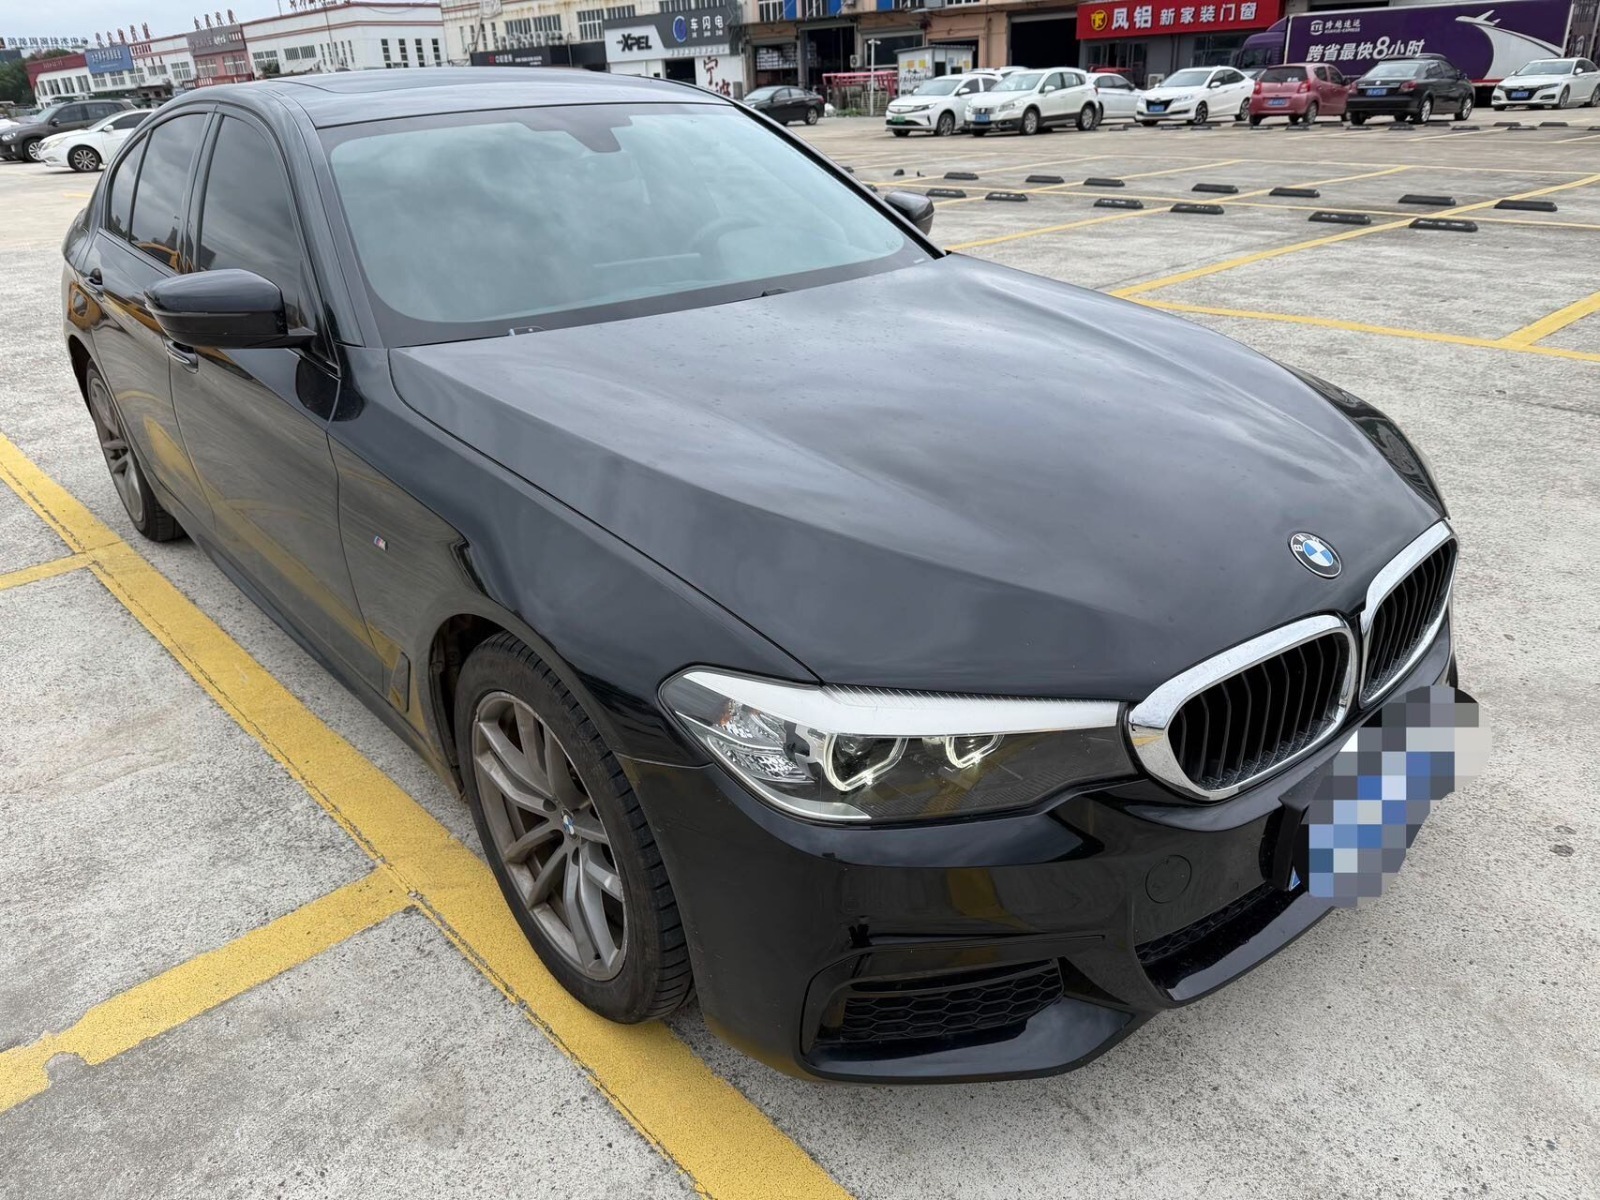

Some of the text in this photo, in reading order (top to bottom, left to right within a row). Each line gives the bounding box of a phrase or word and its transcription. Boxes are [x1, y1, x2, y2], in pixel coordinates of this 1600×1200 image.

[690, 15, 723, 31] 车闪电
[1111, 6, 1152, 30] 凤铝
[1159, 2, 1257, 26] 新家装门窗
[617, 33, 652, 52] XPEL
[1306, 36, 1425, 62] 跨省最快8小时
